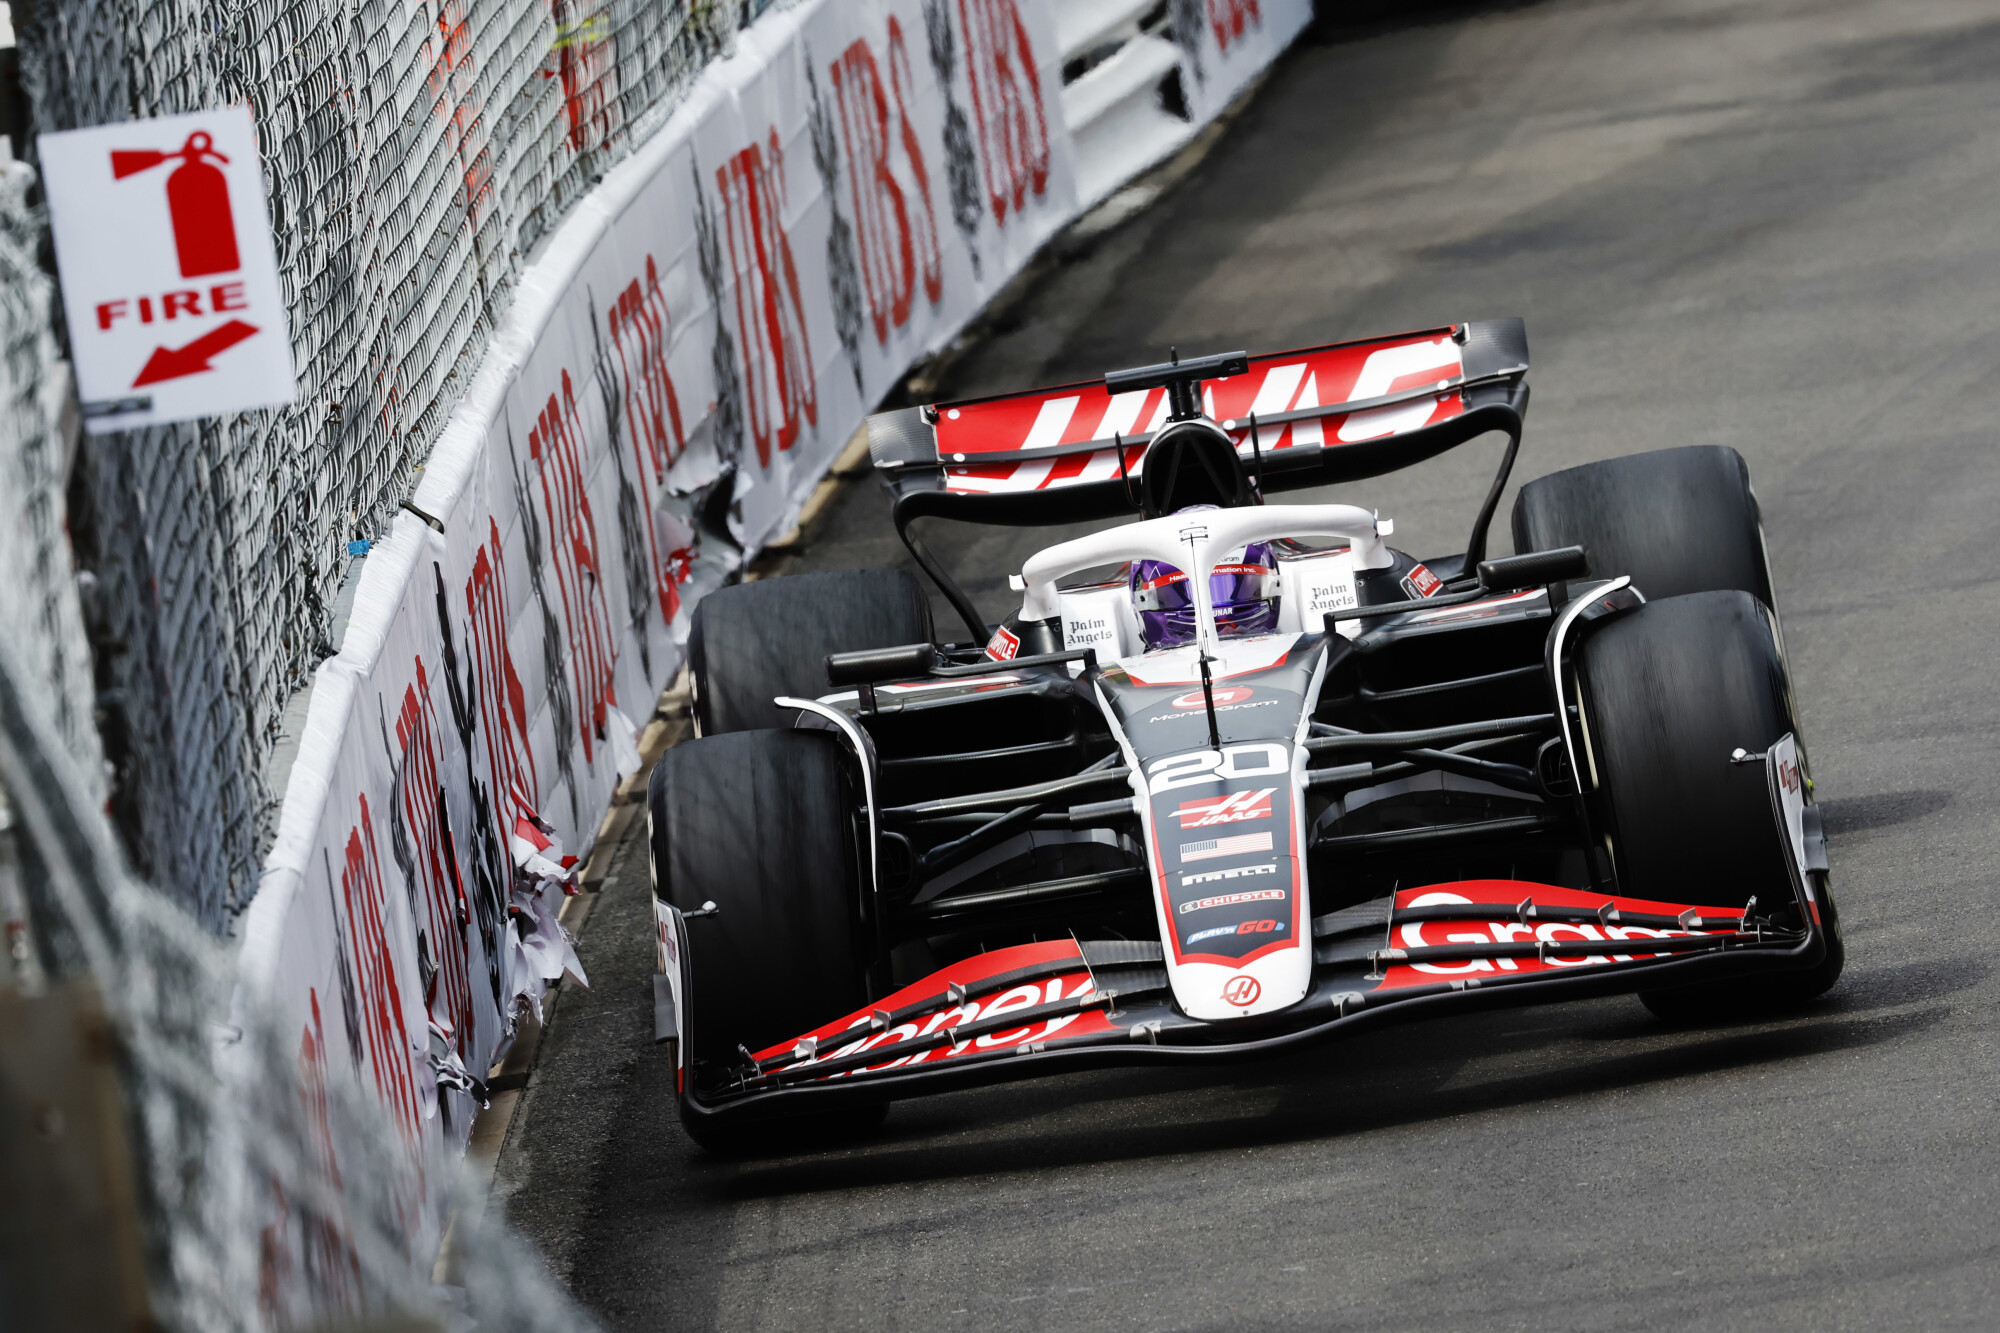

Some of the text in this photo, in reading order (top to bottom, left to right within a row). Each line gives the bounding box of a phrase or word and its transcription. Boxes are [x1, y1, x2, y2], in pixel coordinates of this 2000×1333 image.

[829, 14, 942, 346] UBS
[95, 281, 249, 331] FIRE
[716, 124, 817, 469] UBS
[1312, 584, 1347, 599] Palm
[1211, 607, 1233, 617] UNAR
[1309, 595, 1355, 616] Angels
[1069, 619, 1105, 634] Palm
[1066, 629, 1113, 647] Angels
[1149, 699, 1279, 724] MoneGram
[1147, 743, 1290, 797] 20
[1192, 810, 1262, 828] HAAS
[1181, 863, 1277, 887] PIRELLI
[1201, 890, 1281, 908] CHIPOTLE
[1236, 919, 1277, 935] GO
